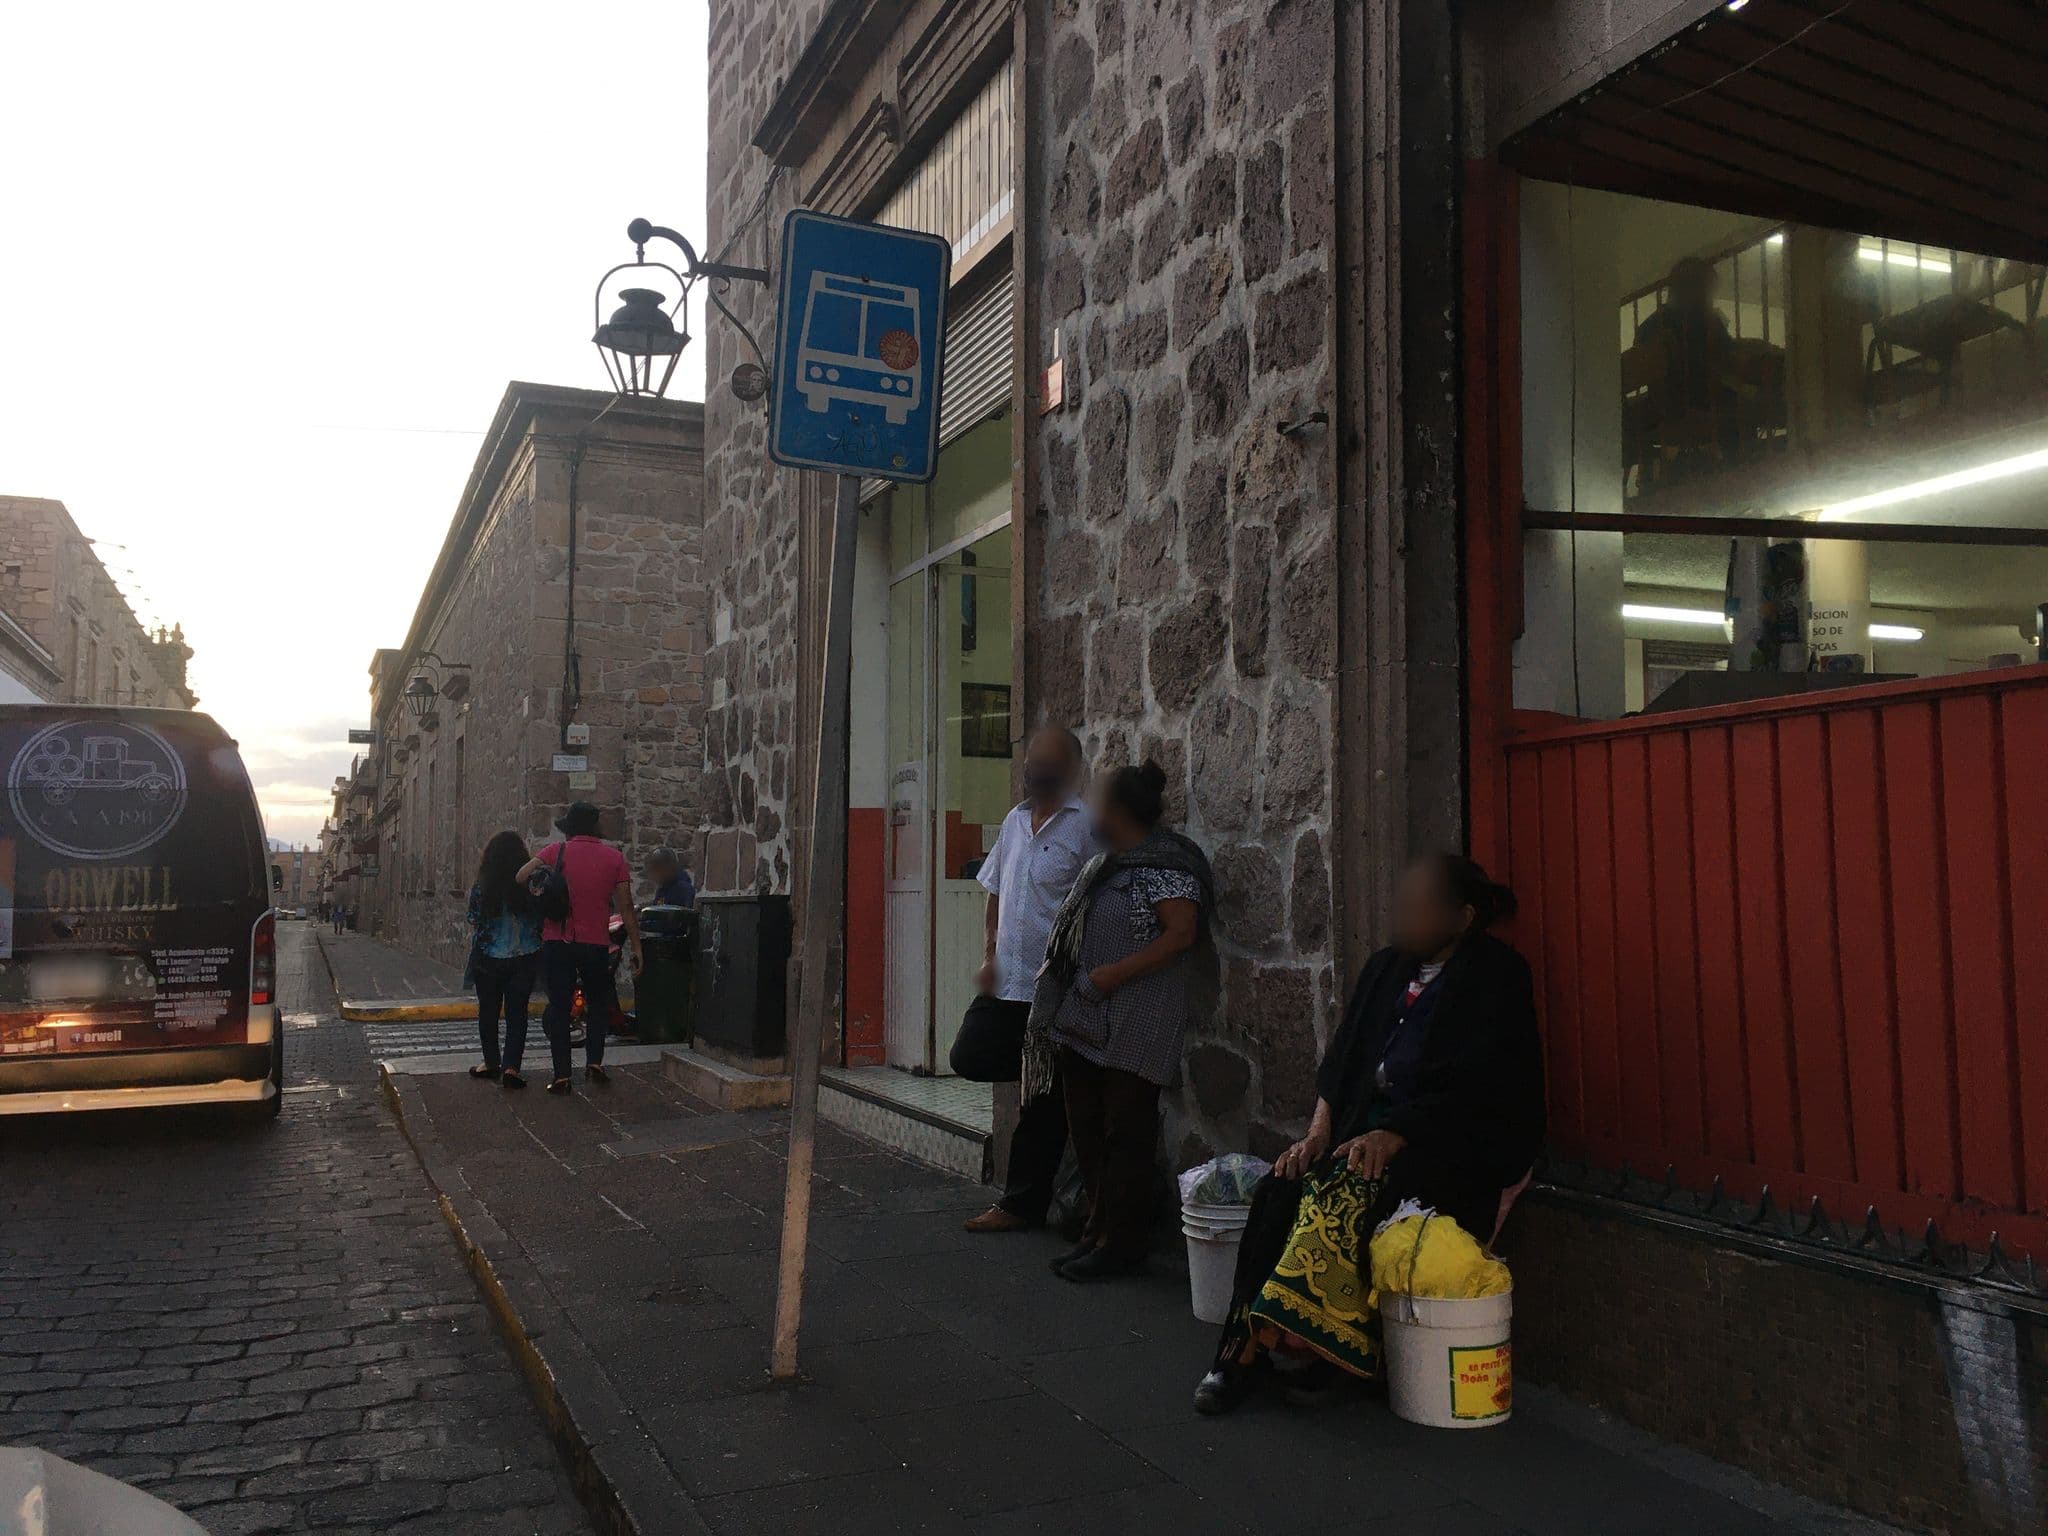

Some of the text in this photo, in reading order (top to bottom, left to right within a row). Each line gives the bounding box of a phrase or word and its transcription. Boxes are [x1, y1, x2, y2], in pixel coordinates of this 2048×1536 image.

[1812, 611, 1849, 620] SICION
[1812, 626, 1844, 636] SO DE
[46, 865, 177, 912] ORWELL
[83, 1029, 122, 1042] orwell
